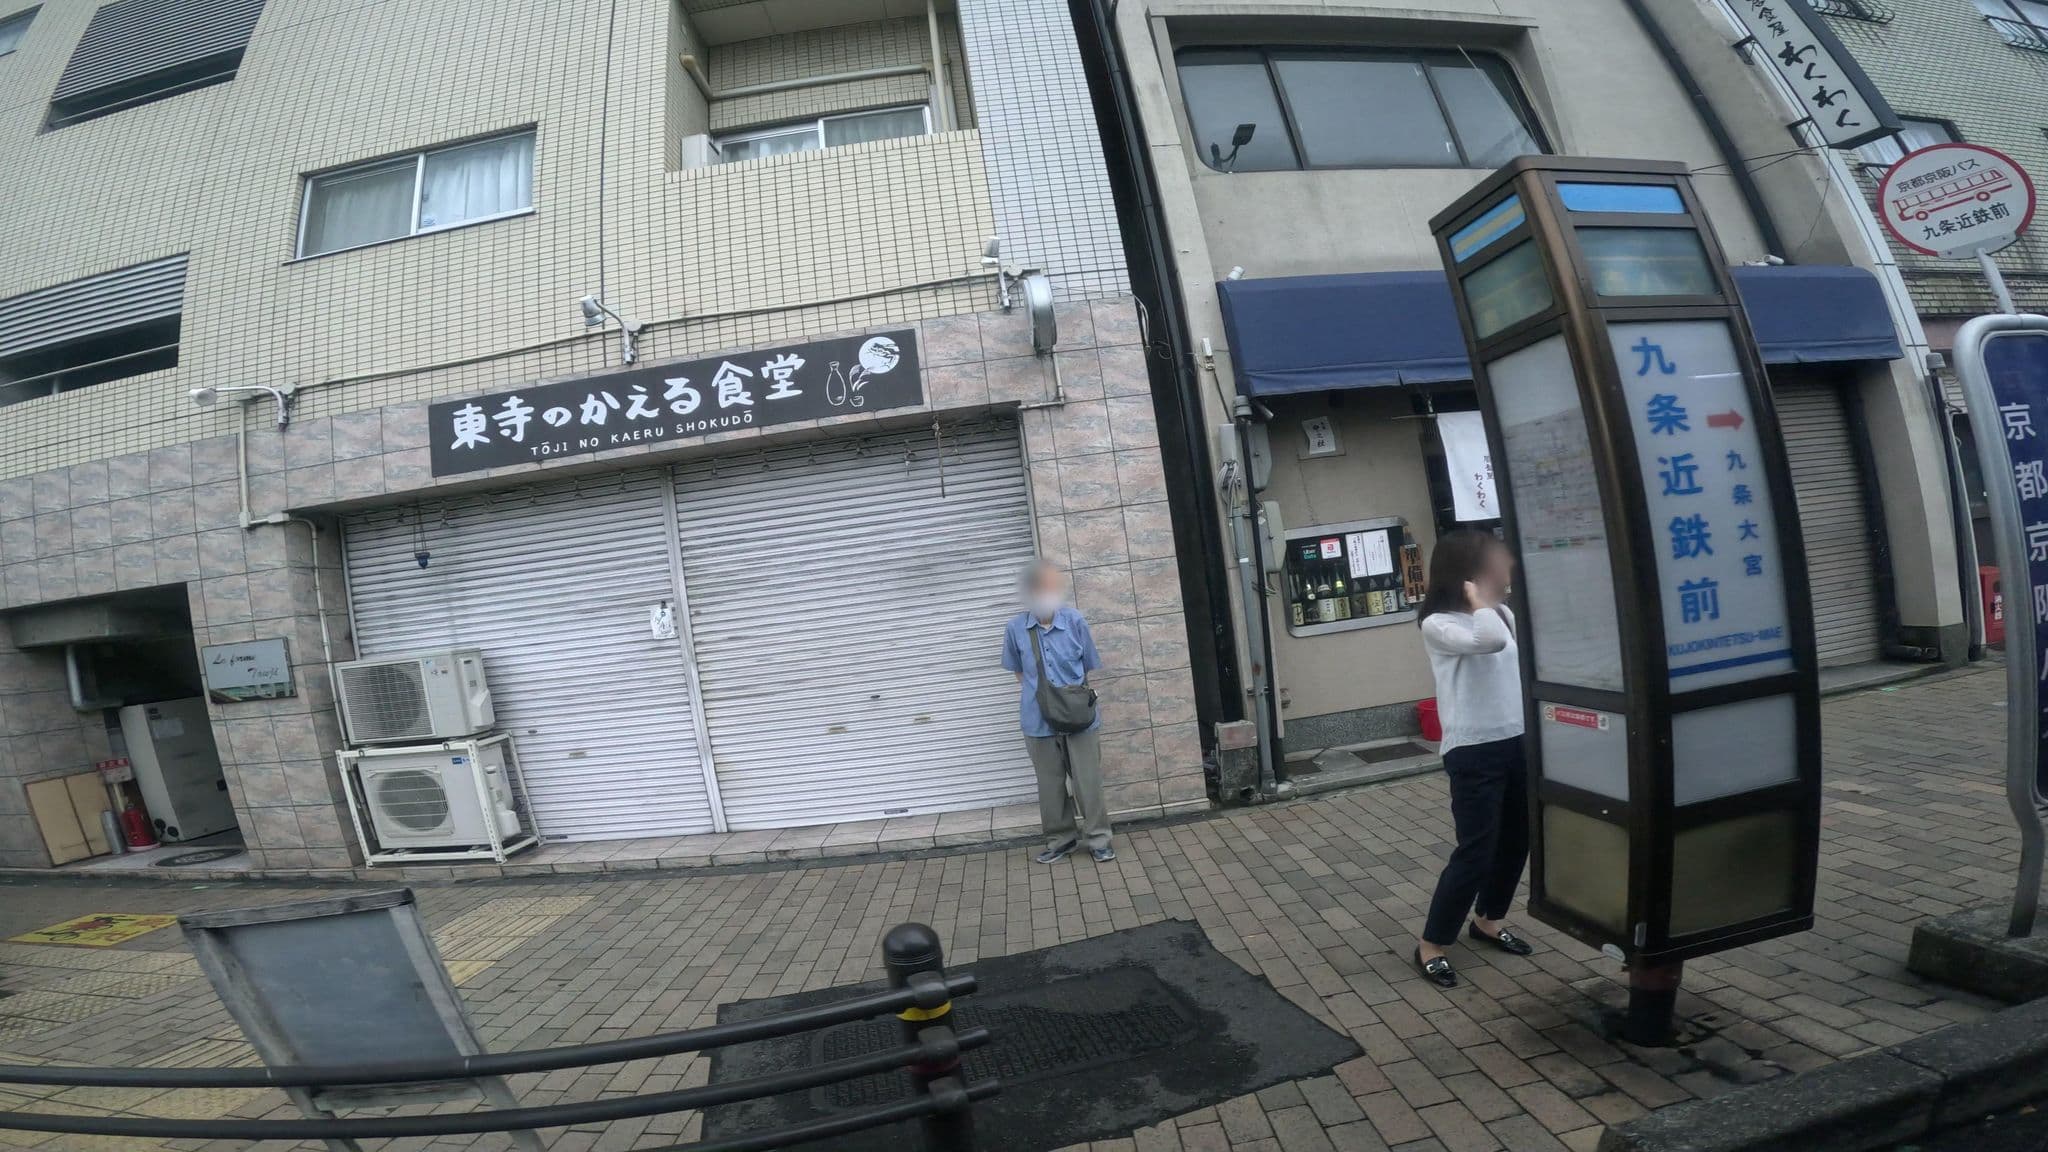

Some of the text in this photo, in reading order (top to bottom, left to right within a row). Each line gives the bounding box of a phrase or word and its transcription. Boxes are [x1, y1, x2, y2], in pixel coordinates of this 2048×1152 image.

[1896, 157, 1981, 193] 京都京阪バス
[1923, 202, 2011, 241] 九条近鉄前
[450, 353, 806, 451] 東寺のかえる食堂
[530, 411, 753, 456] TŌJI NO KAERU SHOKUDŌ
[1474, 471, 1487, 509] わくわく
[1631, 336, 1721, 624] 九条近鉄前
[1726, 449, 1763, 577] 九条大宮
